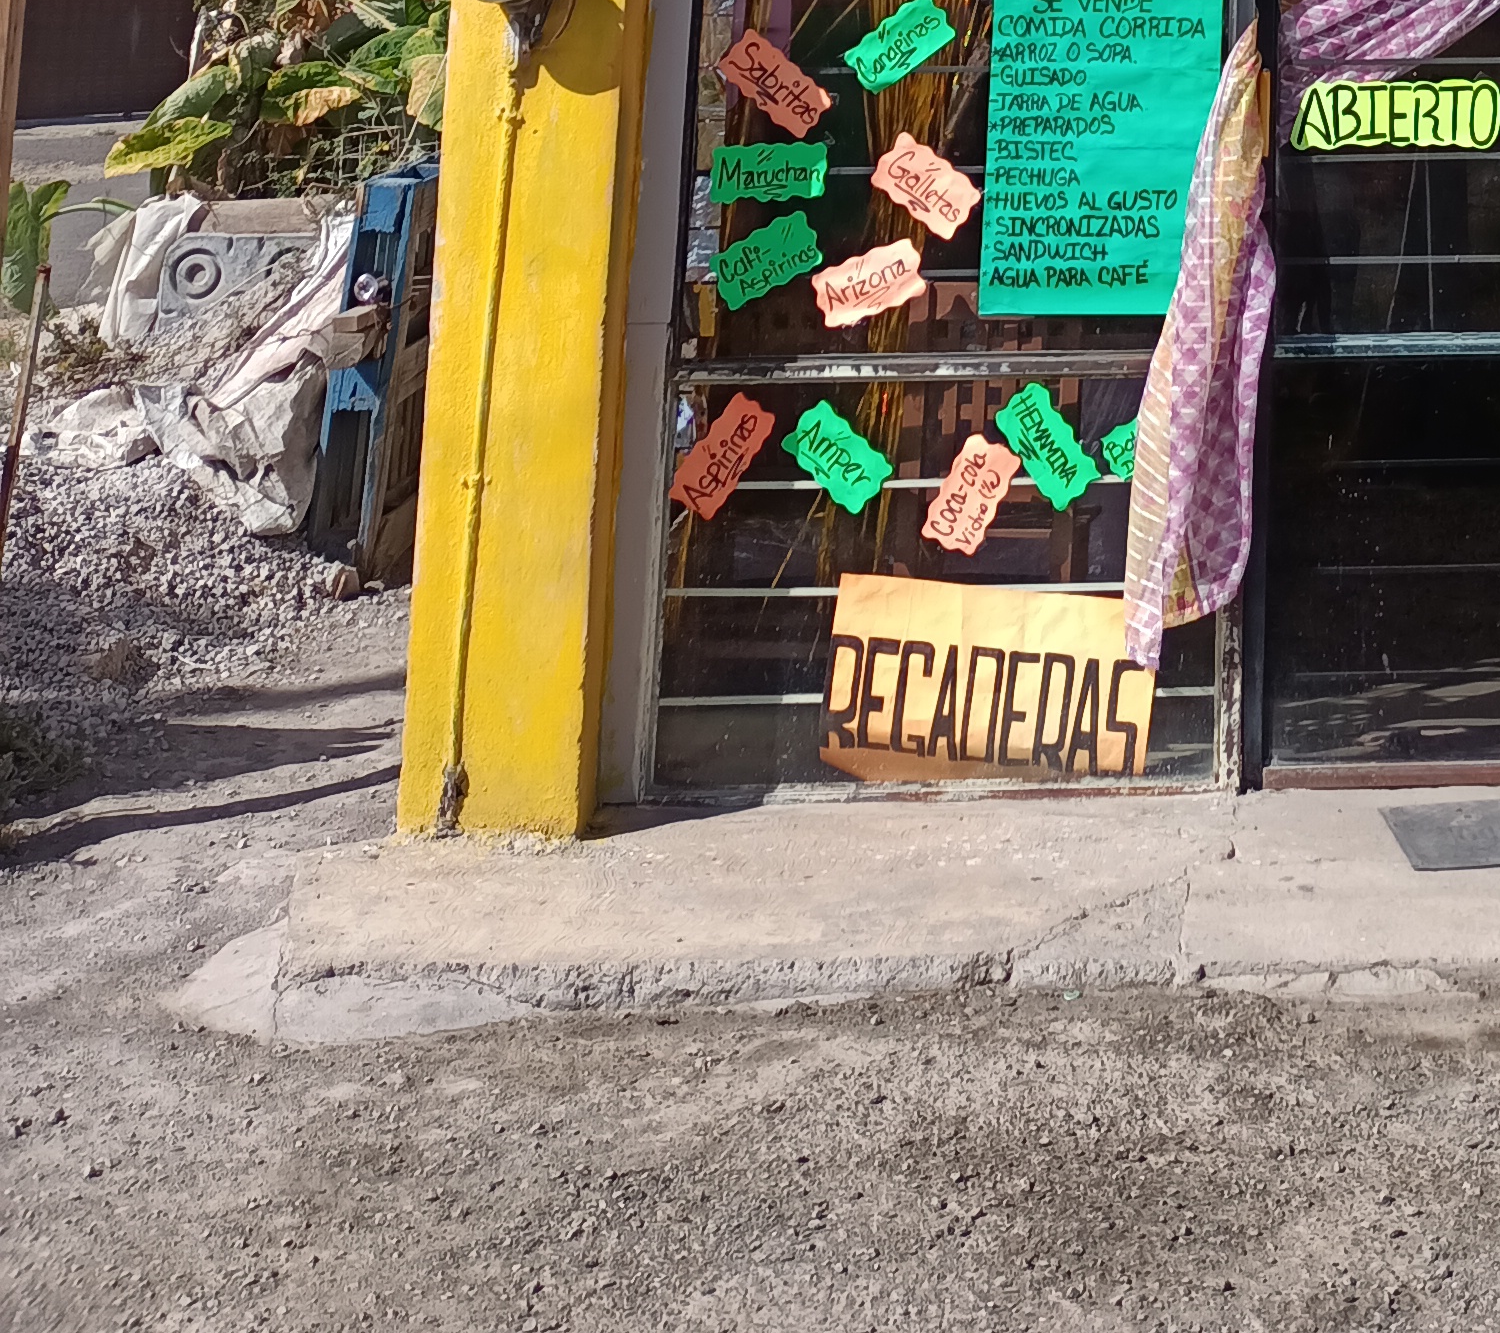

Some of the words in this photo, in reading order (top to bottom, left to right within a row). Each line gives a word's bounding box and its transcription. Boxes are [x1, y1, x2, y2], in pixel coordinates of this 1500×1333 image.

[998, 15, 1086, 38] COMIDA
[1100, 16, 1206, 40] CORRIDA
[999, 42, 1057, 64] ARROZ
[1066, 42, 1081, 62] O
[728, 42, 819, 125] Sabritas
[1056, 93, 1083, 113] DE
[1089, 91, 1143, 112] AGUA
[1297, 83, 1498, 146] ABIERTO
[718, 157, 820, 190] Maruchan
[888, 151, 960, 222] Galletas
[1078, 191, 1102, 210] AL
[1108, 189, 1177, 212] GUSTO
[995, 215, 1160, 238] SINCRONIZADAS
[992, 241, 1108, 263] SANDWICH
[825, 259, 910, 311] Arizona
[989, 266, 1041, 288] AGUA
[1044, 266, 1093, 288] PARA
[1098, 259, 1149, 287] CAFÉ
[821, 634, 1146, 776] REGADERAS
